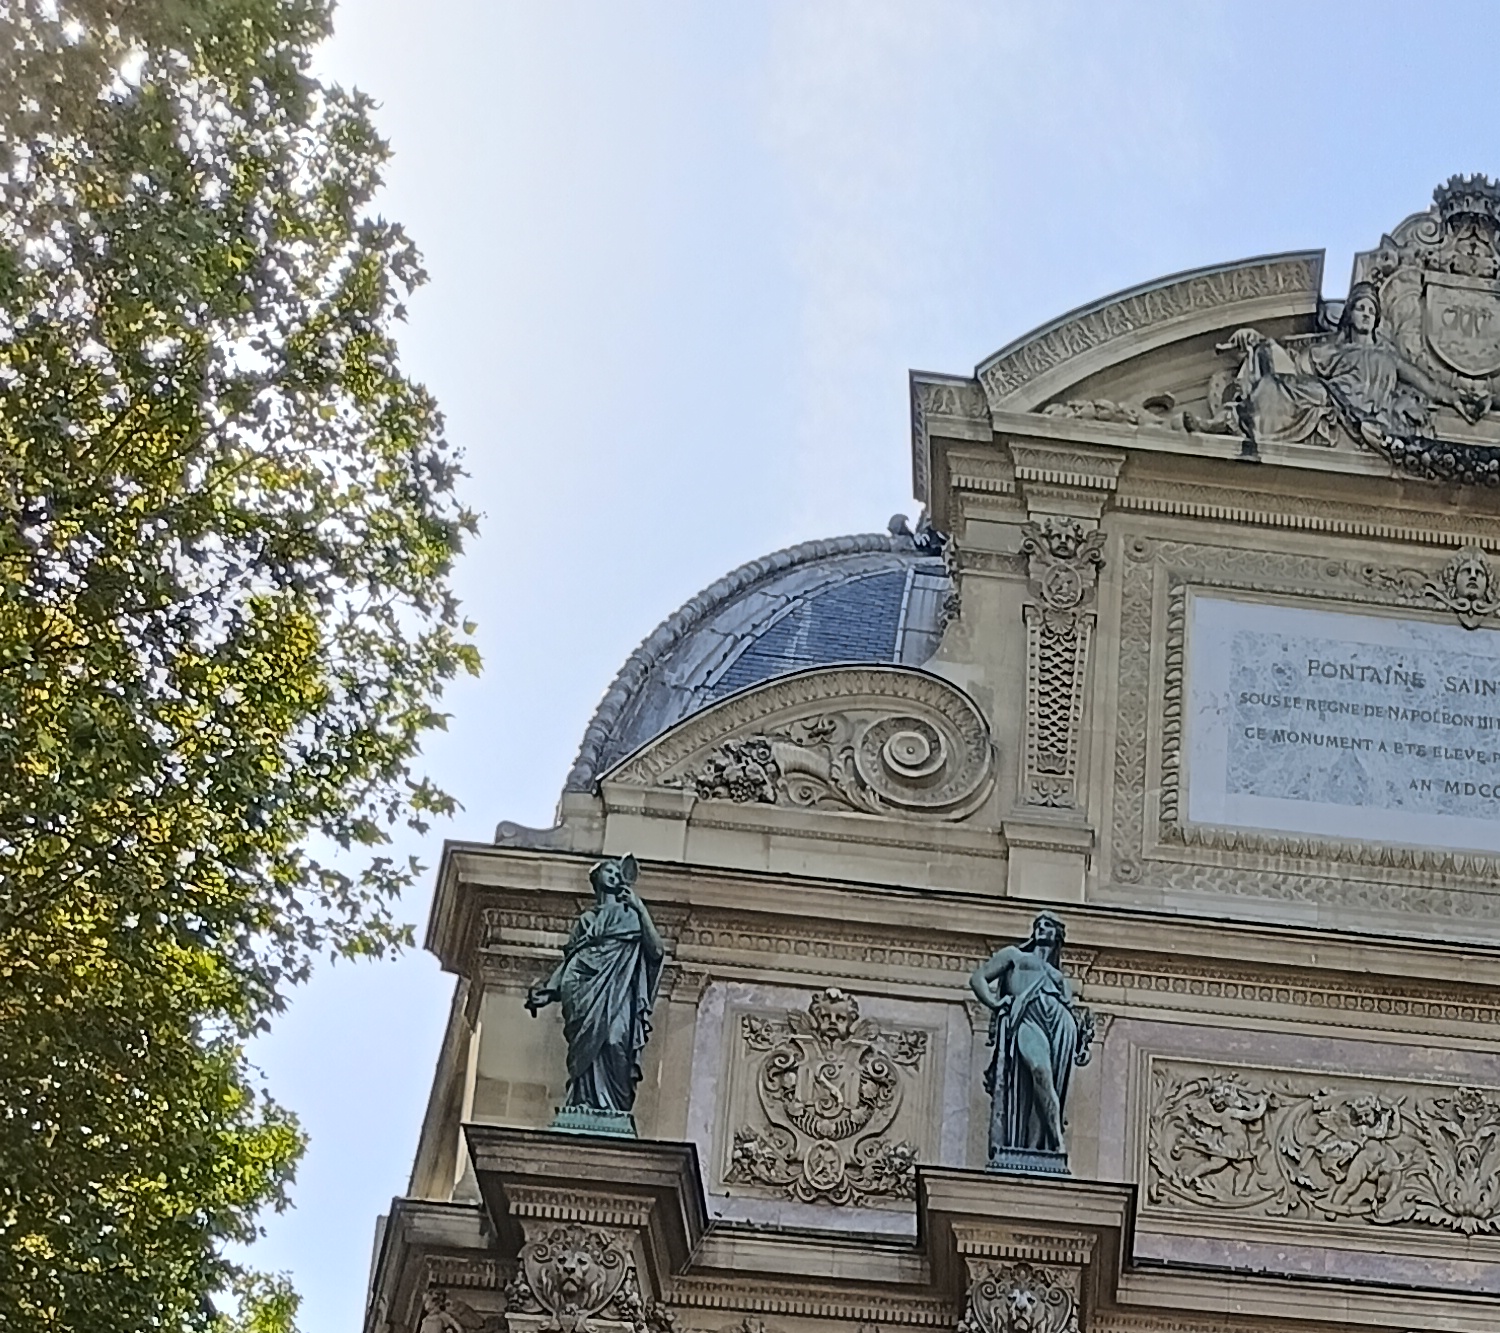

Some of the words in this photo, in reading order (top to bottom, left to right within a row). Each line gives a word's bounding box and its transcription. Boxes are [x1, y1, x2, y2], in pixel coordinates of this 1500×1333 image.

[1308, 659, 1426, 688] FONTAINE
[1239, 692, 1281, 708] SOUS
[1284, 696, 1301, 709] LE
[1306, 699, 1360, 715] REGNE
[1364, 704, 1383, 718] DE
[1388, 706, 1474, 727] NAPOLEON
[1478, 716, 1493, 731] III
[1244, 727, 1266, 741] CE
[1271, 729, 1374, 751] MONUMENT
[1378, 741, 1388, 754] A
[1394, 742, 1427, 757] ETE
[1433, 747, 1486, 765] ELEVE
[1409, 779, 1432, 792] AN
